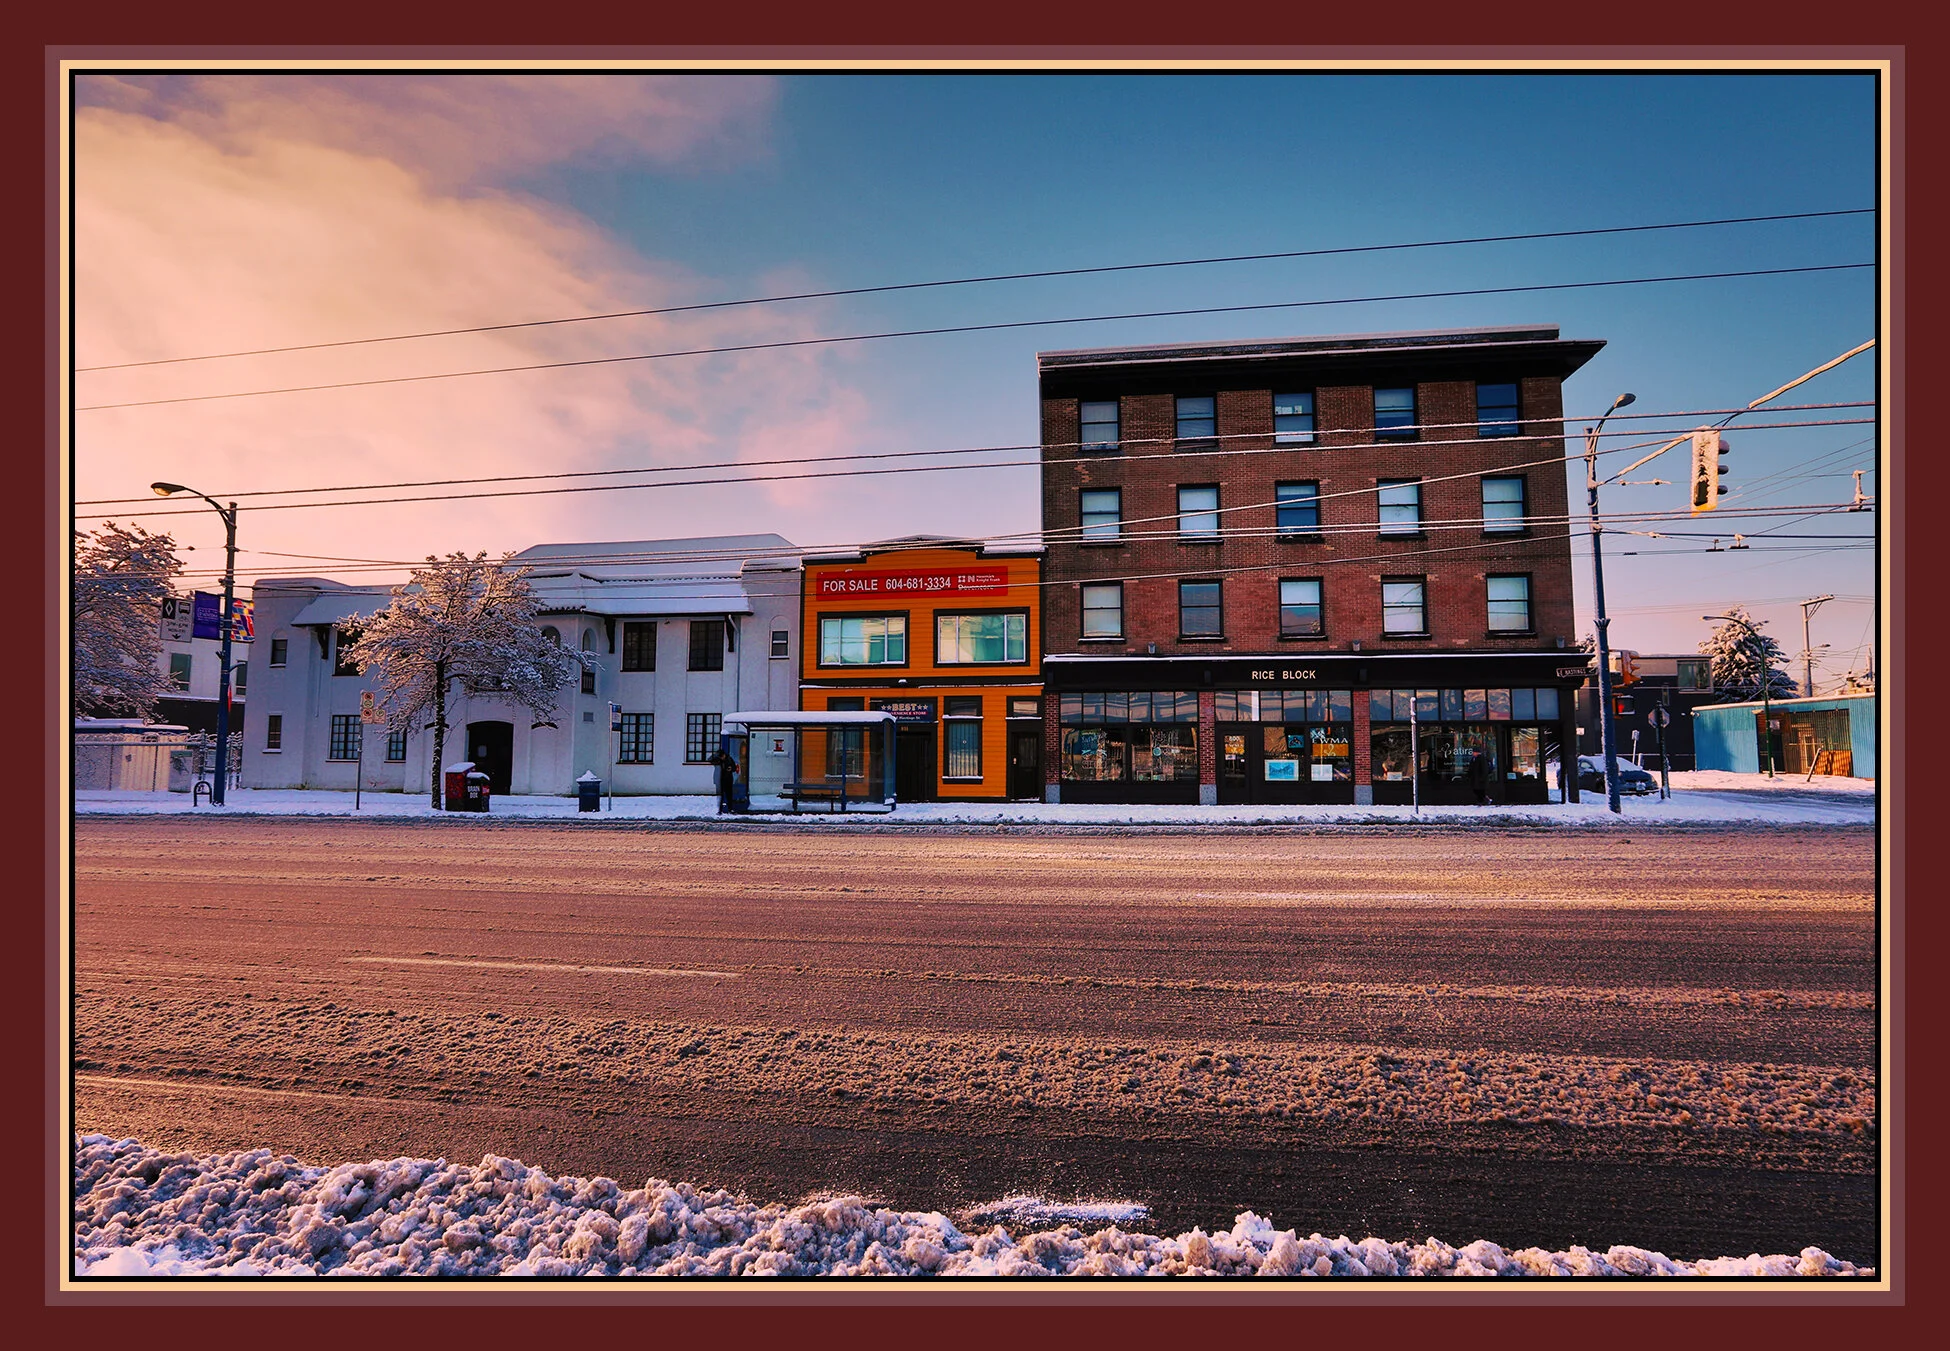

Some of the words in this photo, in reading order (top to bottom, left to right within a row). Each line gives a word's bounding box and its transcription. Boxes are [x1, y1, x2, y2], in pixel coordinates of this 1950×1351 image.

[823, 580, 846, 592] FOR
[849, 579, 878, 591] SALE
[885, 576, 951, 590] 604-681-3334
[1251, 670, 1275, 680] RICE
[1282, 669, 1316, 680] BLOCK
[891, 703, 917, 712] BEST
[1453, 745, 1474, 756] atira
